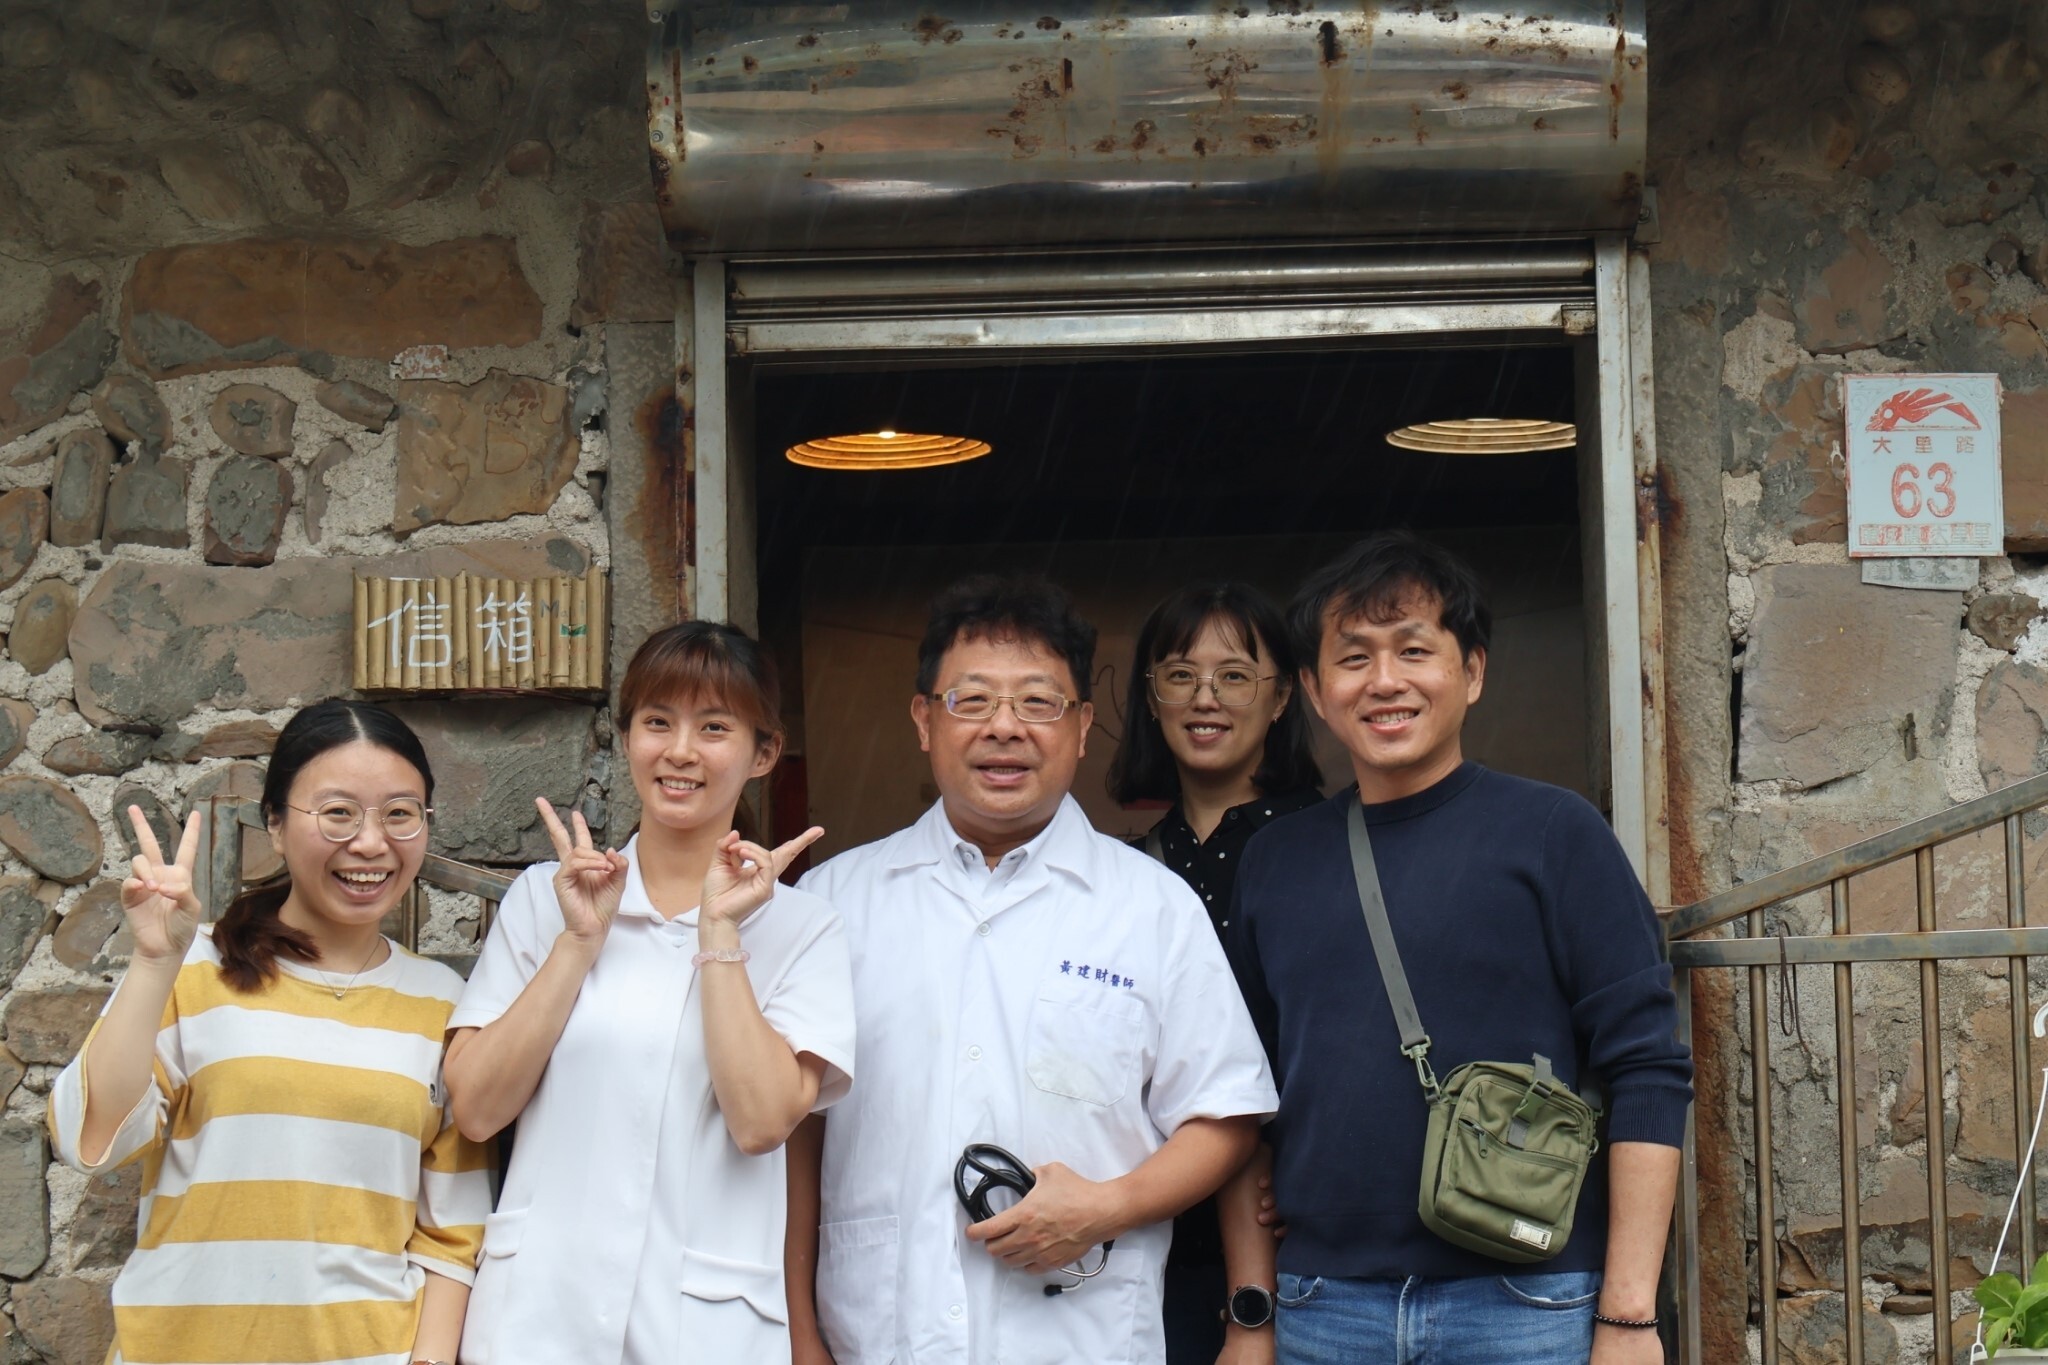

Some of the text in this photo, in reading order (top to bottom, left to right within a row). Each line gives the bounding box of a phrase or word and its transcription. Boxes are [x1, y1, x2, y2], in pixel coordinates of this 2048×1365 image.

[1873, 436, 1975, 454] 大里路
[1891, 462, 1956, 518] 63
[368, 592, 531, 668] 信箱
